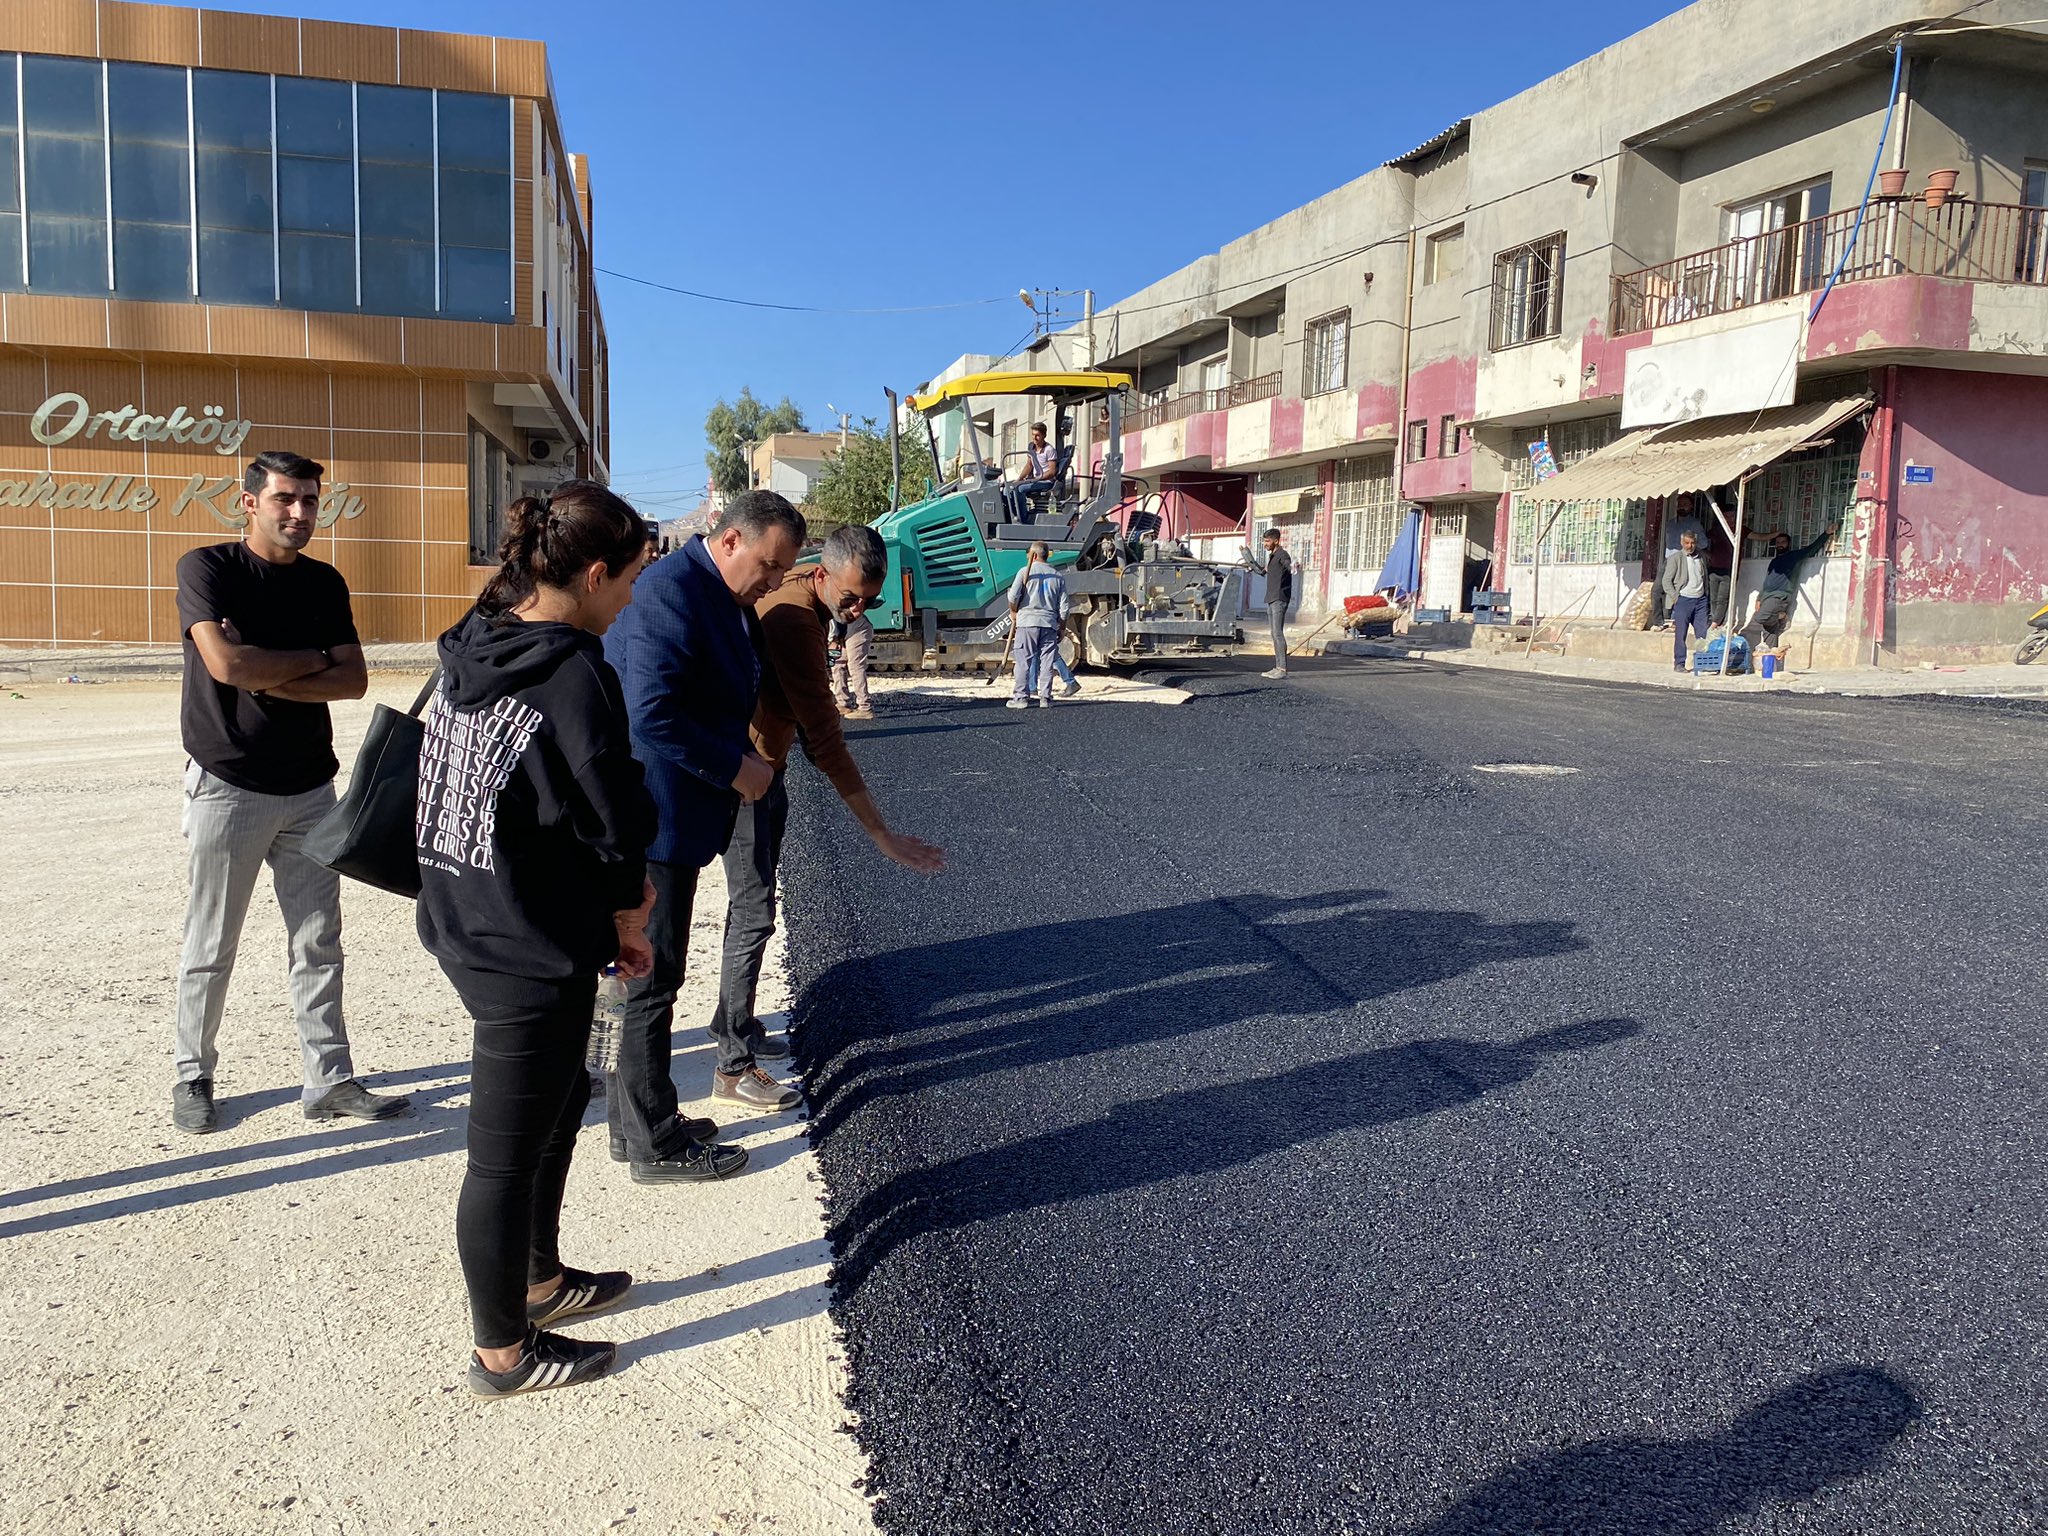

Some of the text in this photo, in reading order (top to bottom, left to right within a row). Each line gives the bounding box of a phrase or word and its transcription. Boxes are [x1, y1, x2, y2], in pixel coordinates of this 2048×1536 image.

[30, 391, 251, 455] Ortaköy
[0, 471, 158, 512] ahalle
[986, 614, 1012, 639] SUPE
[494, 695, 543, 733] CLUB
[450, 721, 482, 754] GIRLS
[483, 715, 531, 752] CLUB
[433, 830, 466, 864] GIRLS
